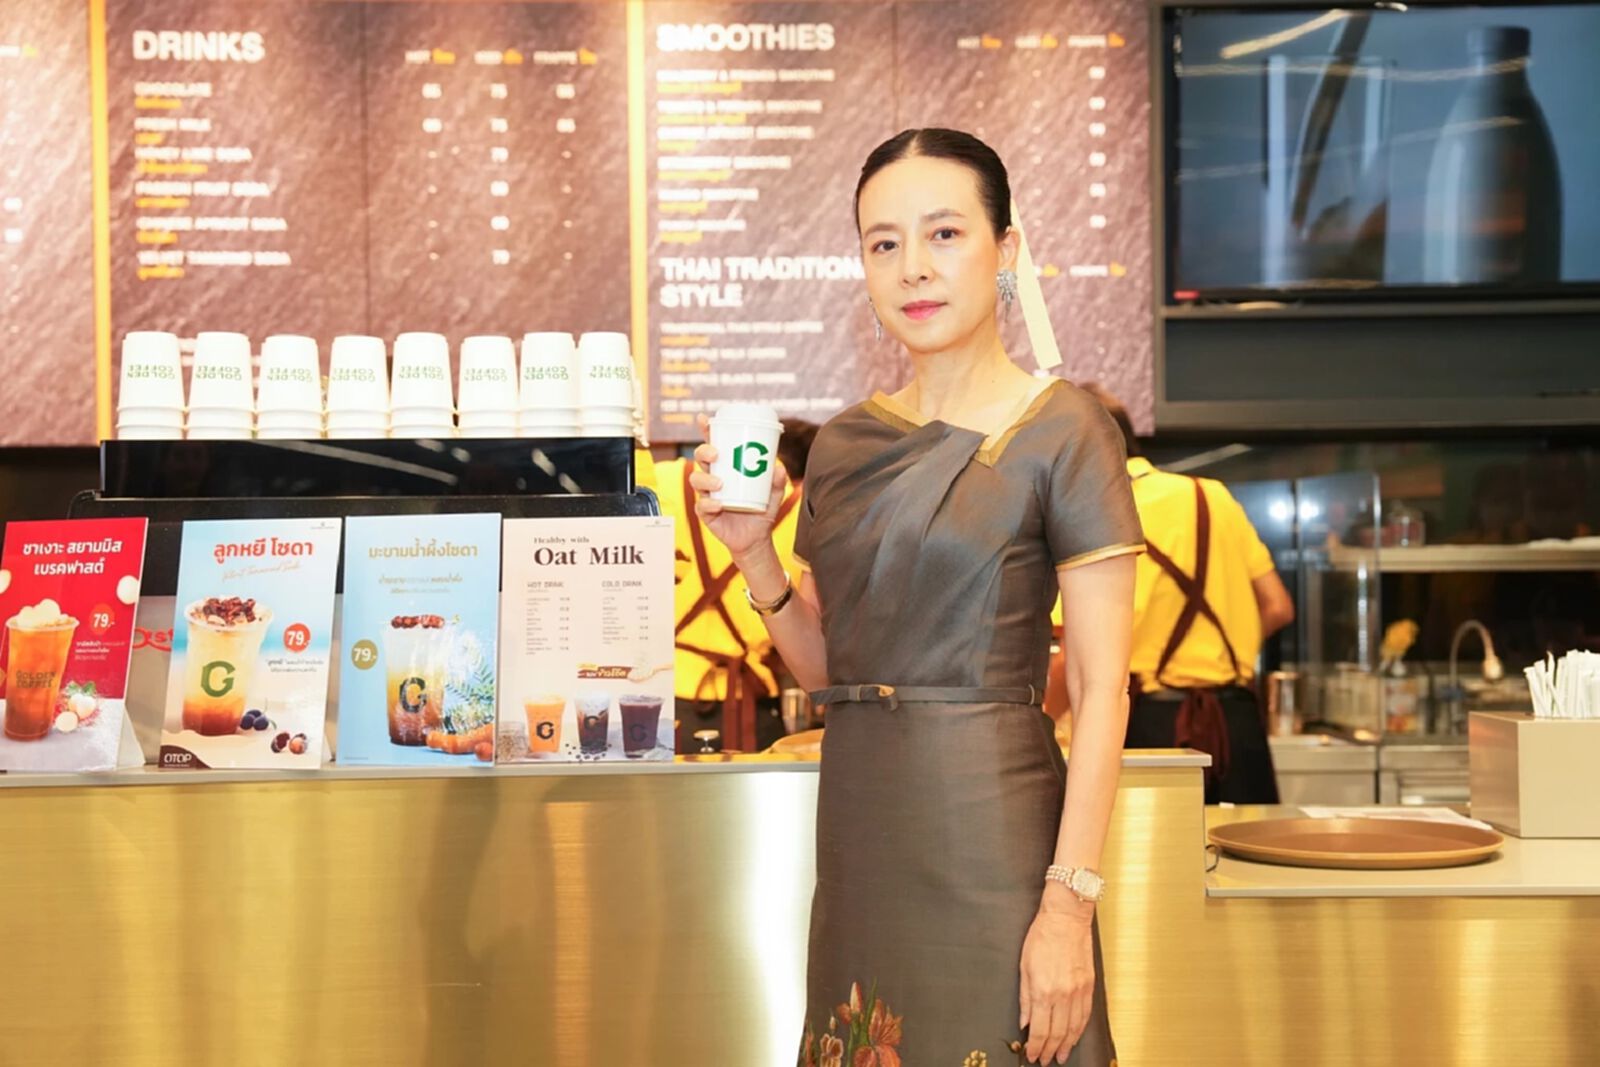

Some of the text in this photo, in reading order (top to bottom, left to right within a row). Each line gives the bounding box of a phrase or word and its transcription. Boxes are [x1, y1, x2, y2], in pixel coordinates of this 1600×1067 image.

[132, 30, 265, 64] DRINKS
[656, 23, 835, 51] SMOOTHIES
[659, 257, 865, 281] THAI TRADITION
[660, 283, 743, 308] STYLE
[23, 543, 65, 555] ชาเงาะ
[214, 537, 266, 564] ลูกหยี
[534, 545, 644, 566] Oat Milk
